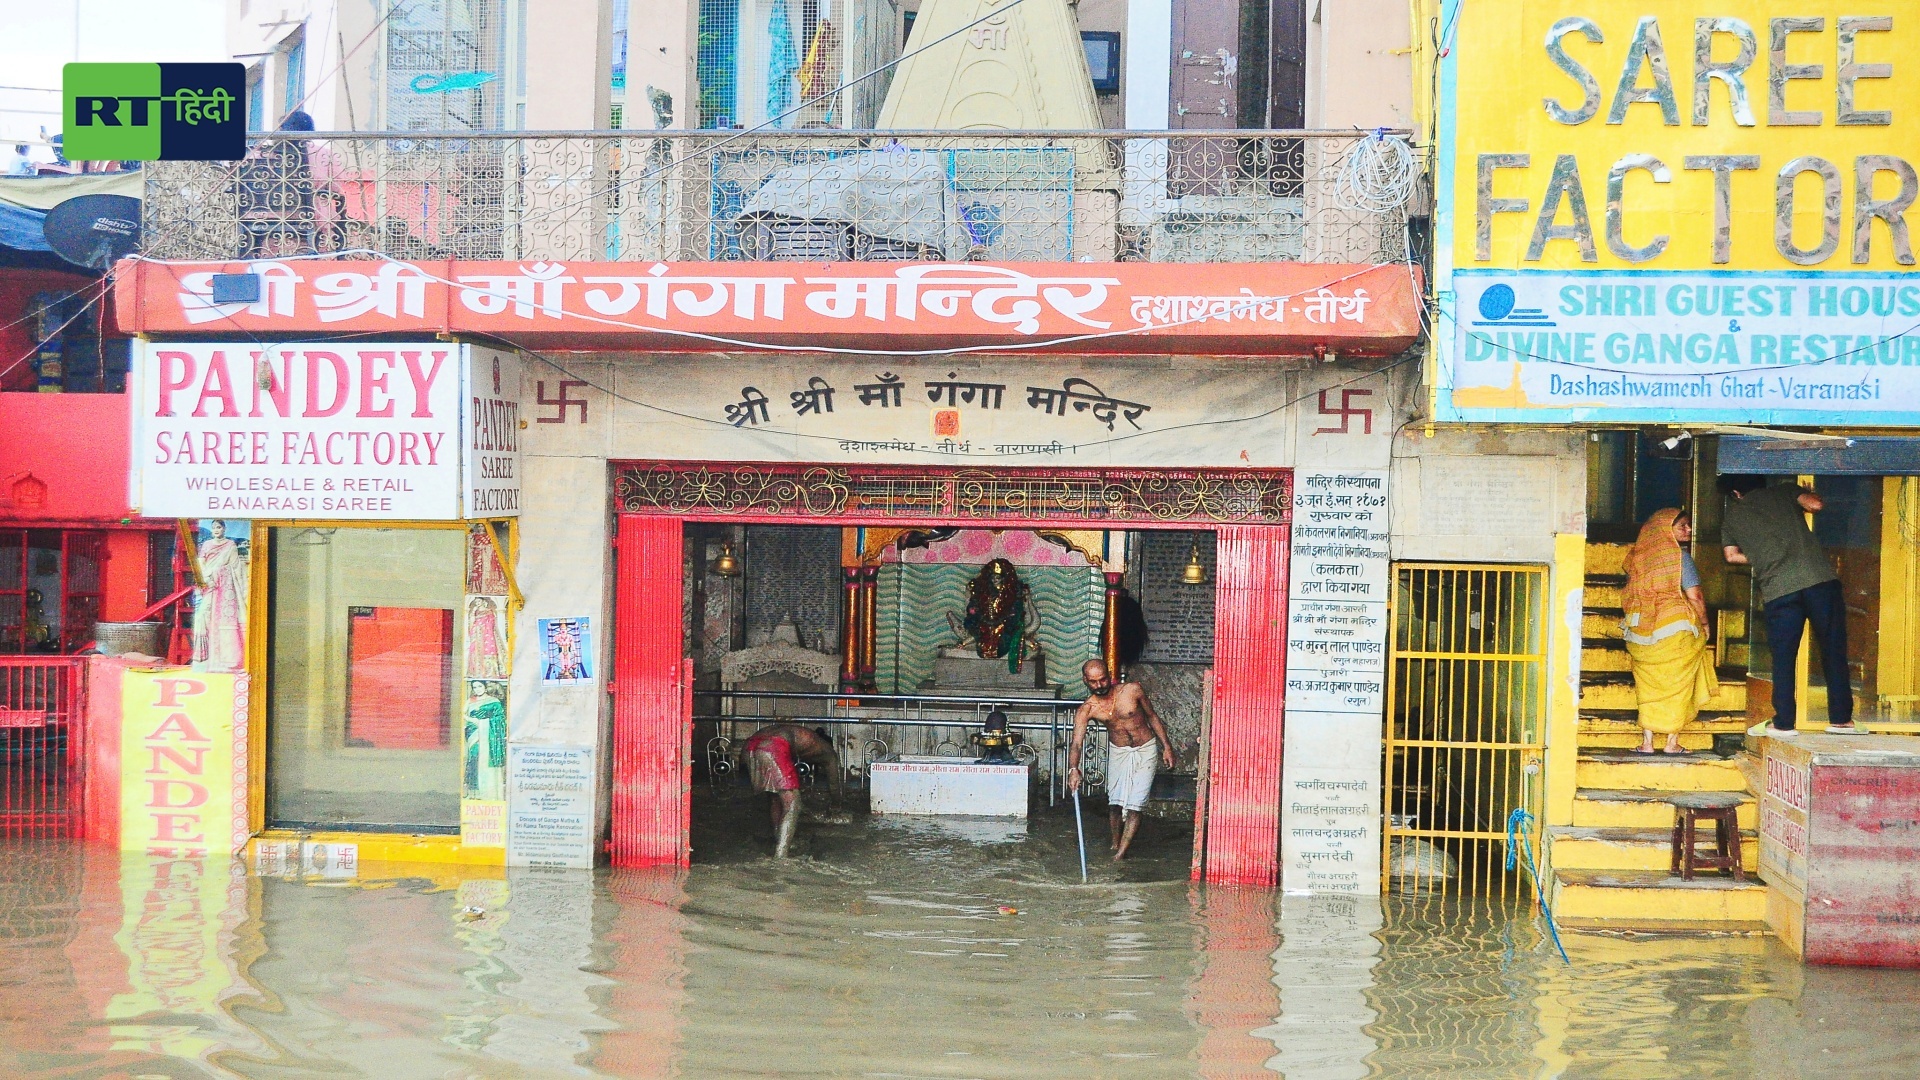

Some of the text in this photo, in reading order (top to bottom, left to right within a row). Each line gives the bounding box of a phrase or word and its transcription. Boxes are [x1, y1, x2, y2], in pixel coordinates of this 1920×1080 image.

[1542, 16, 1893, 126] SAREE
[1474, 154, 1919, 265] FACTOR
[178, 261, 305, 324] श्री
[314, 261, 437, 323] श्री
[457, 261, 578, 320] माँ
[582, 262, 797, 321] गंगा
[804, 264, 1121, 335] मन्दिर
[1558, 284, 1920, 318] SHRI GUEST HOUS
[1728, 319, 1741, 333] &
[1465, 331, 1596, 364] DIVINE
[1604, 332, 1741, 366] GANGA
[154, 350, 448, 419] PANDEY
[724, 371, 1151, 431] श्री श्री माँ गंगा मन्दिर
[473, 397, 518, 452] PANDEY
[155, 431, 445, 467] SAREE FACTORY
[936, 438, 971, 454] तीर्थ
[994, 440, 1064, 455] वाराणसी
[481, 456, 513, 479] SAREE
[186, 477, 414, 492] WHOLESALE & RETAIL
[1306, 474, 1381, 490] मन्दिर की स्थापना
[208, 497, 392, 511] BANARASI SAREE
[473, 488, 520, 511] FACTORY
[1305, 494, 1323, 508] जून
[1310, 510, 1373, 522] गुरुवार को
[1295, 525, 1304, 538] श्री
[1311, 562, 1364, 577] (कलकत्ता)
[1301, 579, 1370, 594] द्वारा किया गया
[1293, 613, 1303, 624] श्री
[1304, 613, 1314, 624] श्री
[1329, 615, 1348, 625] गंगा
[1330, 641, 1350, 653] लाल
[1352, 639, 1382, 654] पाण्डेय
[145, 678, 211, 858] PANDE
[465, 805, 503, 816] PANDEY
[465, 832, 503, 843] FACTORY
